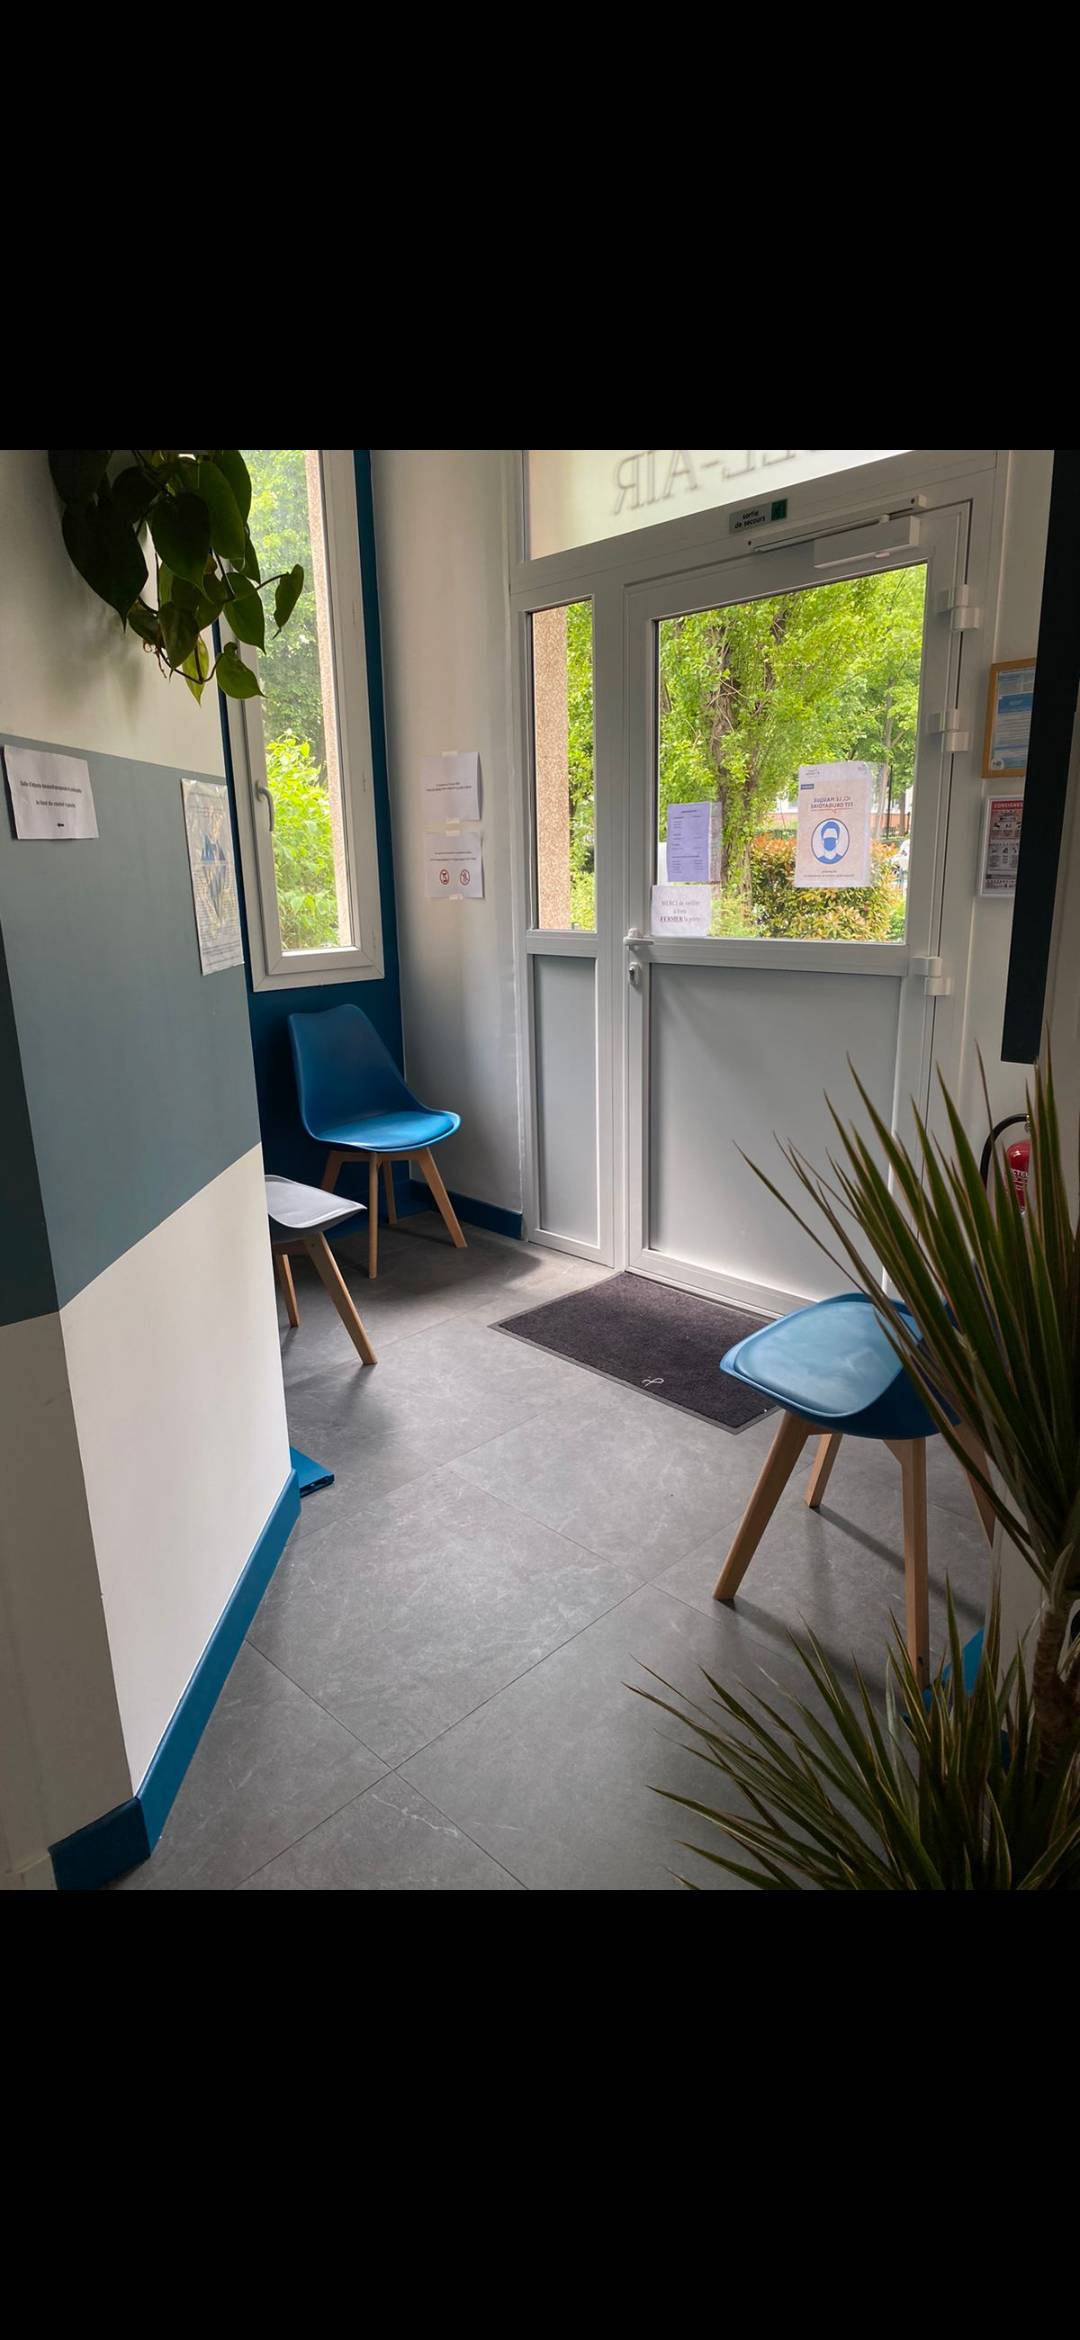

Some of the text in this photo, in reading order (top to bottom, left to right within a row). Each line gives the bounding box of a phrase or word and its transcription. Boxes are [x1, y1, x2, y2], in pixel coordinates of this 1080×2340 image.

[742, 510, 760, 520] sortie
[734, 516, 766, 529] de secours
